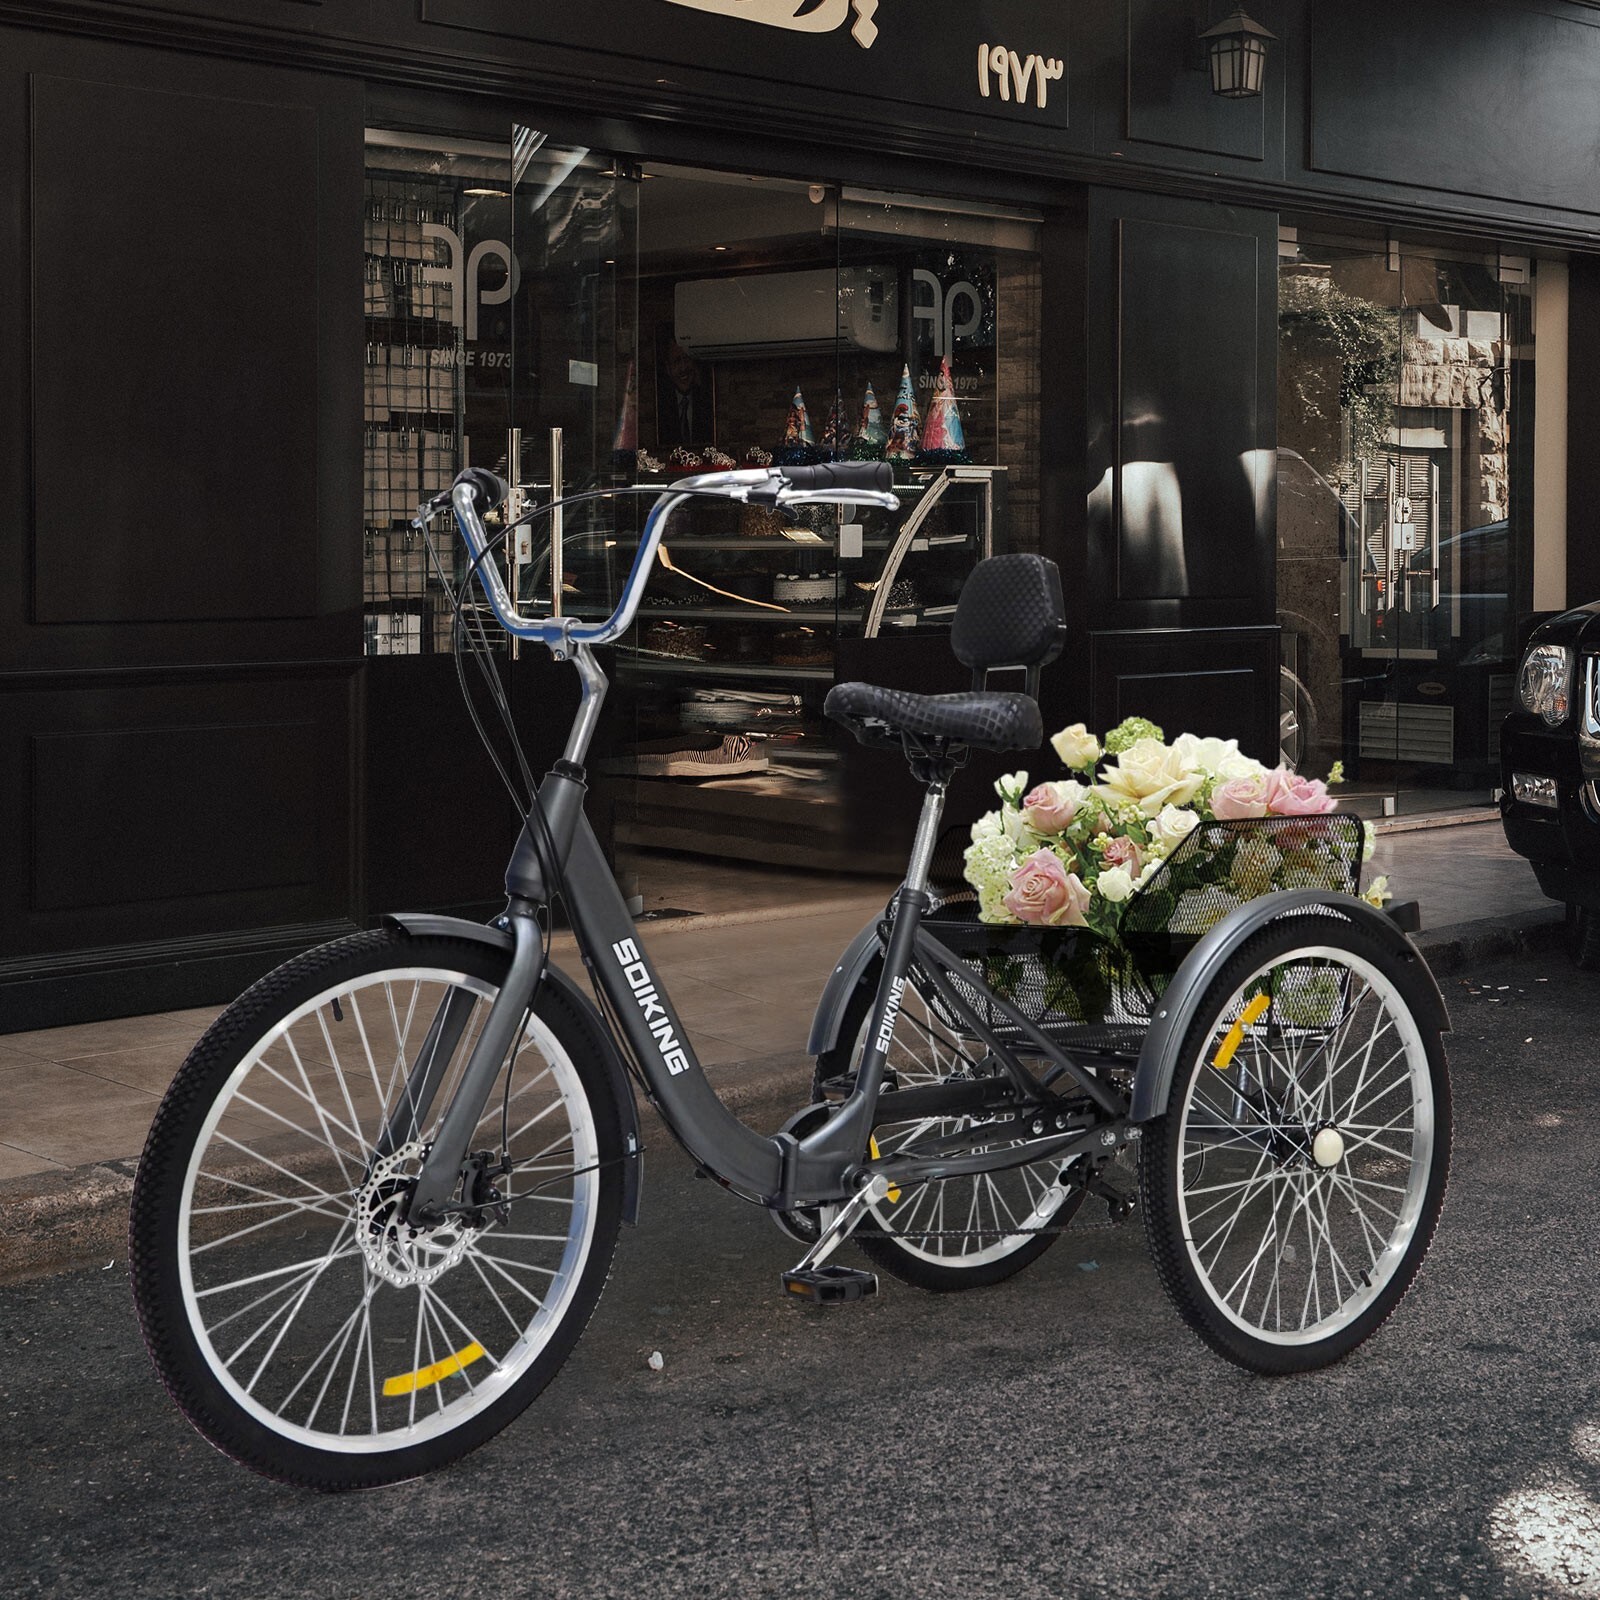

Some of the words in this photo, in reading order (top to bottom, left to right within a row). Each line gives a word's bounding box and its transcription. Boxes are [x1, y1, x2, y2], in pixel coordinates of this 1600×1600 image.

[978, 43, 1063, 108] ١٩٧٣
[430, 349, 475, 366] SINCE
[480, 352, 511, 368] 1973
[954, 376, 978, 390] 1973
[612, 937, 690, 1076] SOIKING
[875, 975, 905, 1055] SOIKING
